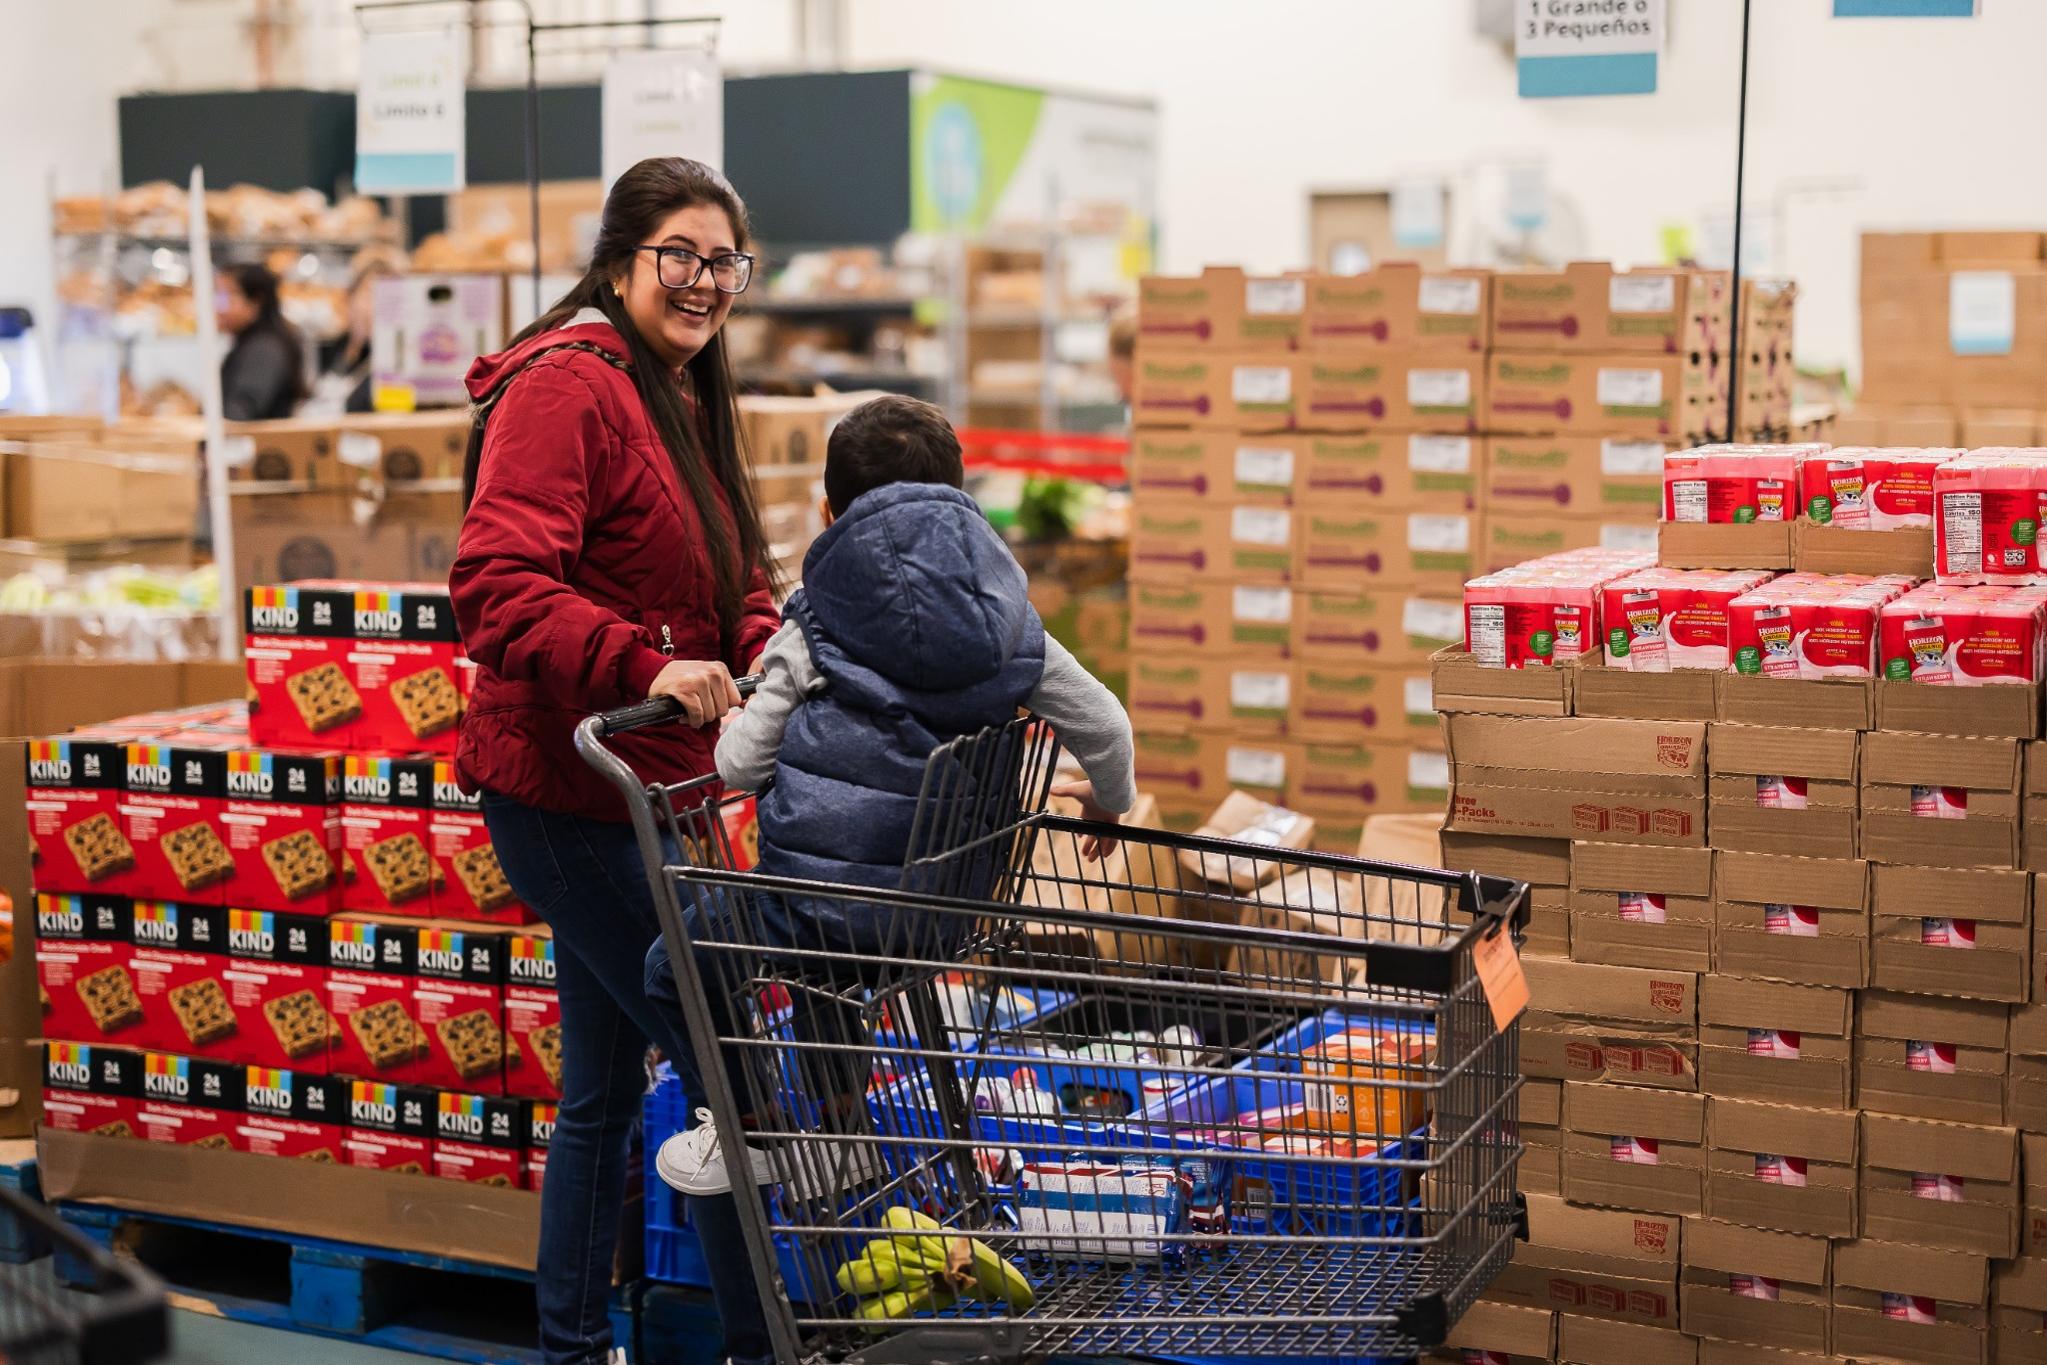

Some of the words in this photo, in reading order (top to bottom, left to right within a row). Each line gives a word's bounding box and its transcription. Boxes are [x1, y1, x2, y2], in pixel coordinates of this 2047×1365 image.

[1548, 0, 1627, 17] Grande
[1525, 20, 1537, 39] 3
[1544, 17, 1650, 42] Pequeños
[252, 606, 299, 629] KIND
[354, 610, 403, 633] KIND
[1627, 607, 1659, 619] HORIZON
[1758, 625, 1791, 637] HORIZON
[1908, 635, 1944, 648] HORIZON
[1915, 673, 1952, 682] STRAWBERRY
[1656, 735, 1692, 746] HORIZON
[30, 759, 71, 779] KIND
[127, 764, 172, 785] KIND
[227, 772, 273, 793] KIND
[344, 776, 391, 797] KIND
[38, 912, 83, 932] KIND
[134, 920, 178, 941] KIND
[229, 929, 274, 951] KIND
[330, 940, 375, 963] KIND
[383, 938, 402, 955] 24
[418, 949, 464, 971] KIND
[471, 948, 490, 964] 24
[510, 957, 557, 979] KIND
[1649, 980, 1685, 992] HORIZON
[49, 1063, 91, 1083] KIND
[104, 1060, 120, 1075] 24
[145, 1073, 189, 1096] KIND
[204, 1072, 221, 1088] 24
[246, 1086, 292, 1109] KIND
[307, 1086, 325, 1101] 24
[351, 1101, 397, 1124] KIND
[404, 1100, 422, 1116] 24
[438, 1111, 484, 1135] KIND
[491, 1112, 510, 1128] 24
[1634, 1219, 1668, 1232] HORIZON
